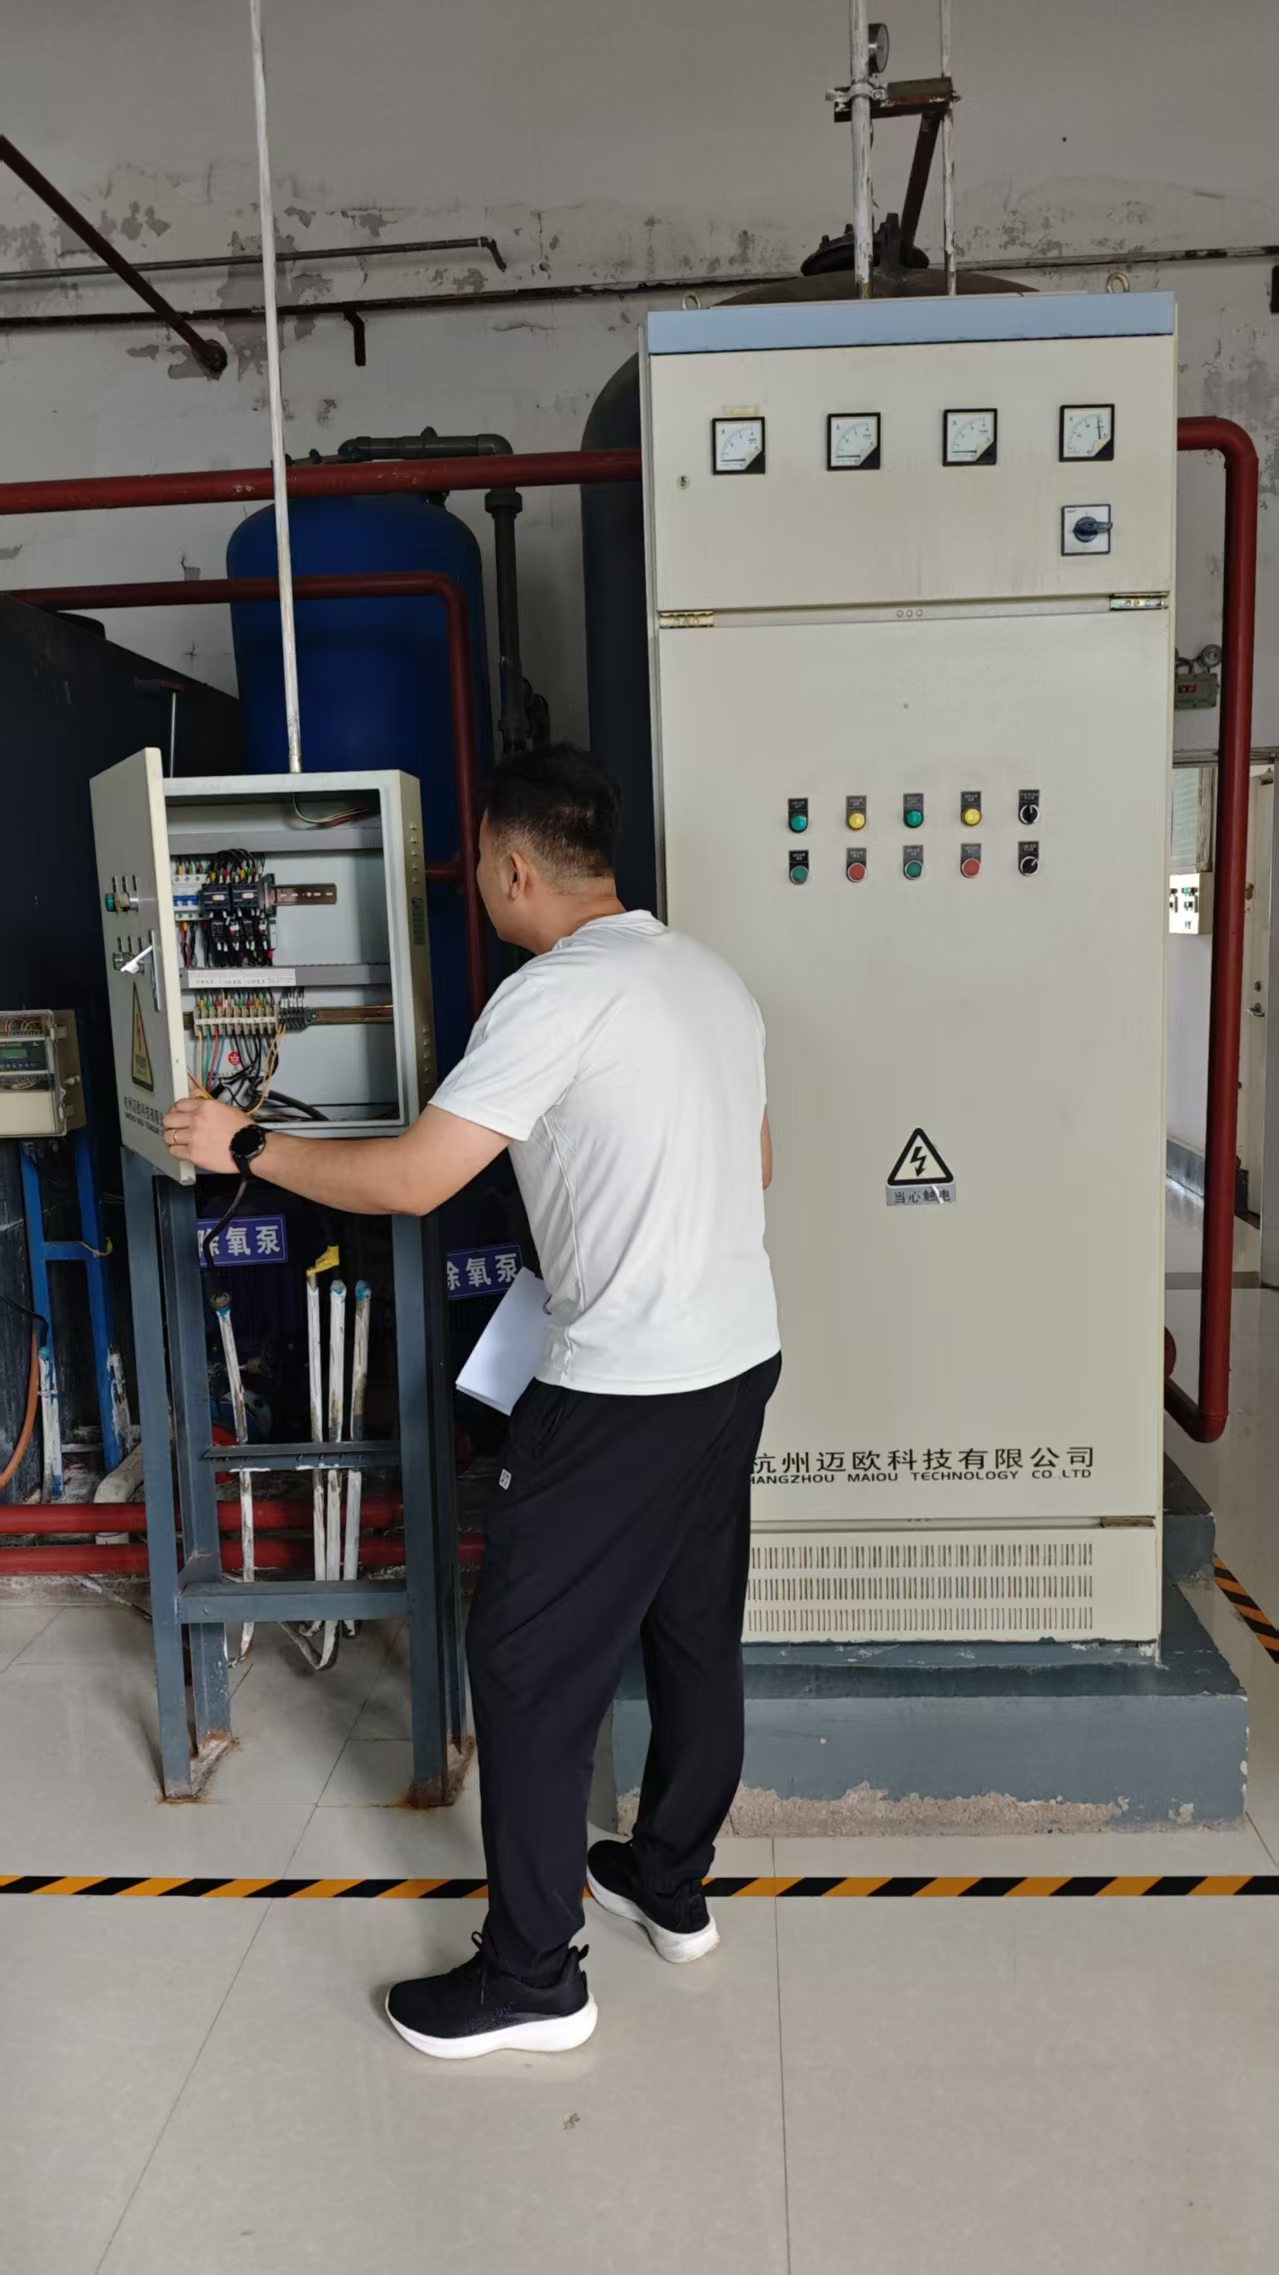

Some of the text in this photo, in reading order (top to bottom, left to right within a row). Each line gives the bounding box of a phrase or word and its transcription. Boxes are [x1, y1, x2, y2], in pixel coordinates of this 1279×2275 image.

[894, 1189, 951, 1204] 当心触电
[752, 1446, 1094, 1474] 杭州迈欧科技有限公司
[848, 1472, 898, 1482] MAIOU
[911, 1470, 1019, 1481] TECHNOLOGY
